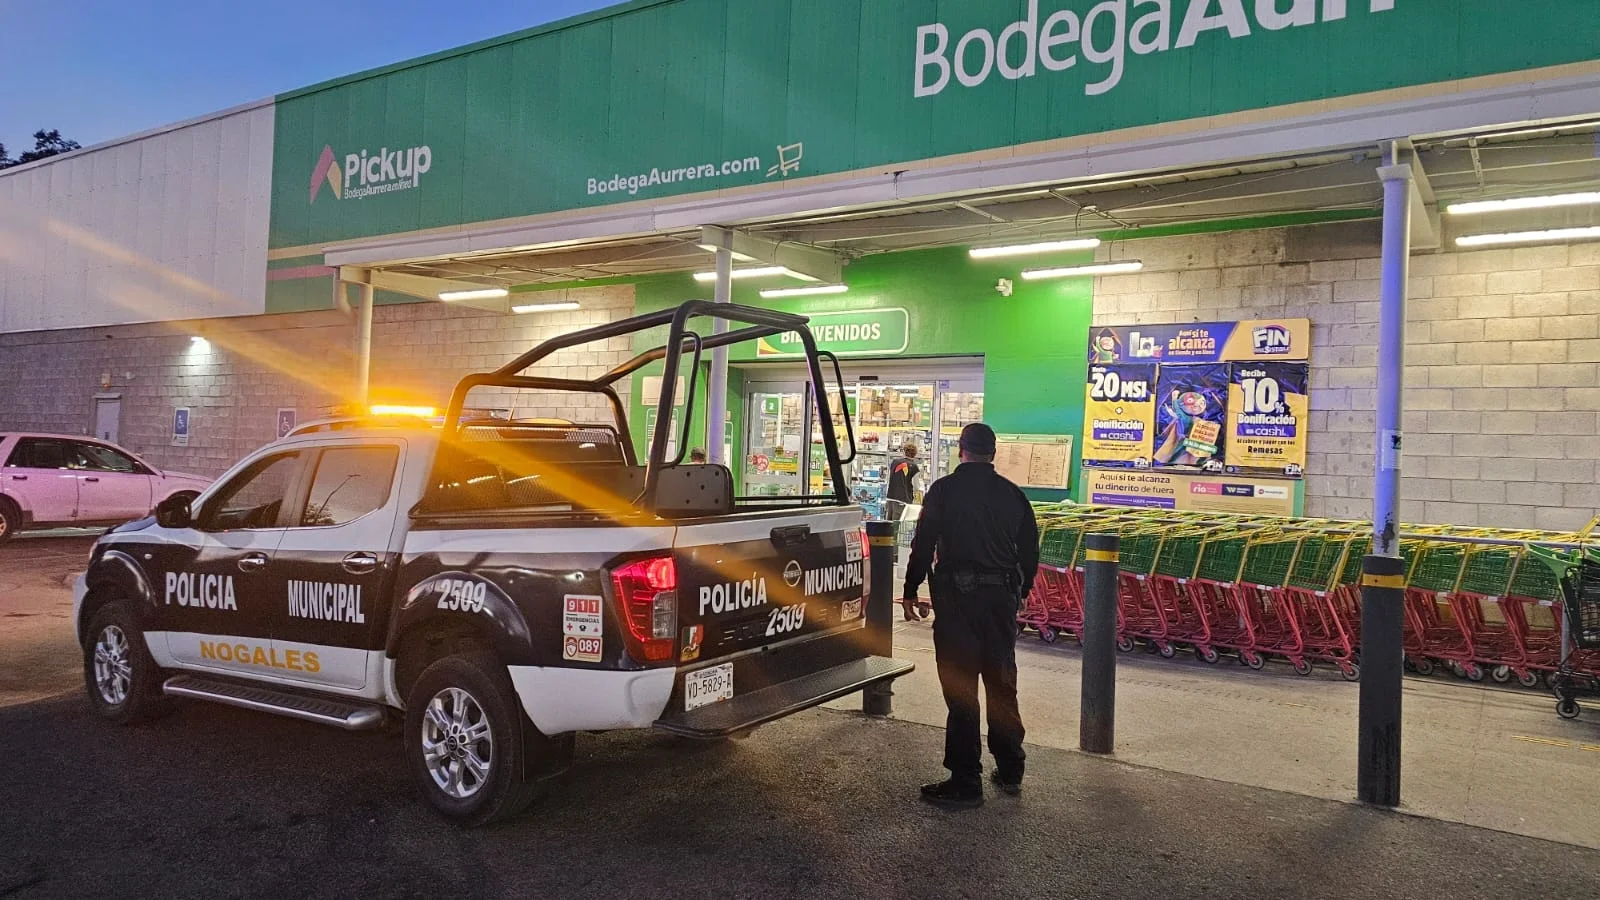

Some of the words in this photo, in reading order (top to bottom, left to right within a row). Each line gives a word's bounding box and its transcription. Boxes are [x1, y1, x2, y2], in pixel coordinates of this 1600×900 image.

[344, 145, 431, 188] Pickup
[587, 156, 760, 195] BodegaAurrera.com
[781, 322, 881, 344] BIEVENIDOS
[1168, 336, 1216, 350] alcanza
[1253, 329, 1290, 348] FIN
[1241, 369, 1266, 377] Recibe
[1090, 372, 1120, 399] 20
[1120, 381, 1147, 398] MSI
[1093, 419, 1144, 430] Bonificación
[1238, 413, 1296, 425] Bonificación
[1247, 445, 1283, 455] Remesas
[1099, 473, 1118, 482] Aquí
[1137, 475, 1170, 484] alcanza
[1105, 483, 1139, 492] dinerito
[1152, 486, 1175, 494] fuera
[804, 561, 863, 597] MUNICIPAL
[165, 571, 238, 611] POLICIA
[287, 579, 365, 624] MUNICIPAL
[437, 578, 486, 613] 2509
[699, 572, 767, 616] POLICÍA
[568, 600, 597, 612] 911
[765, 602, 807, 637] 2509
[200, 640, 321, 673] NOGALES
[579, 639, 600, 653] 089
